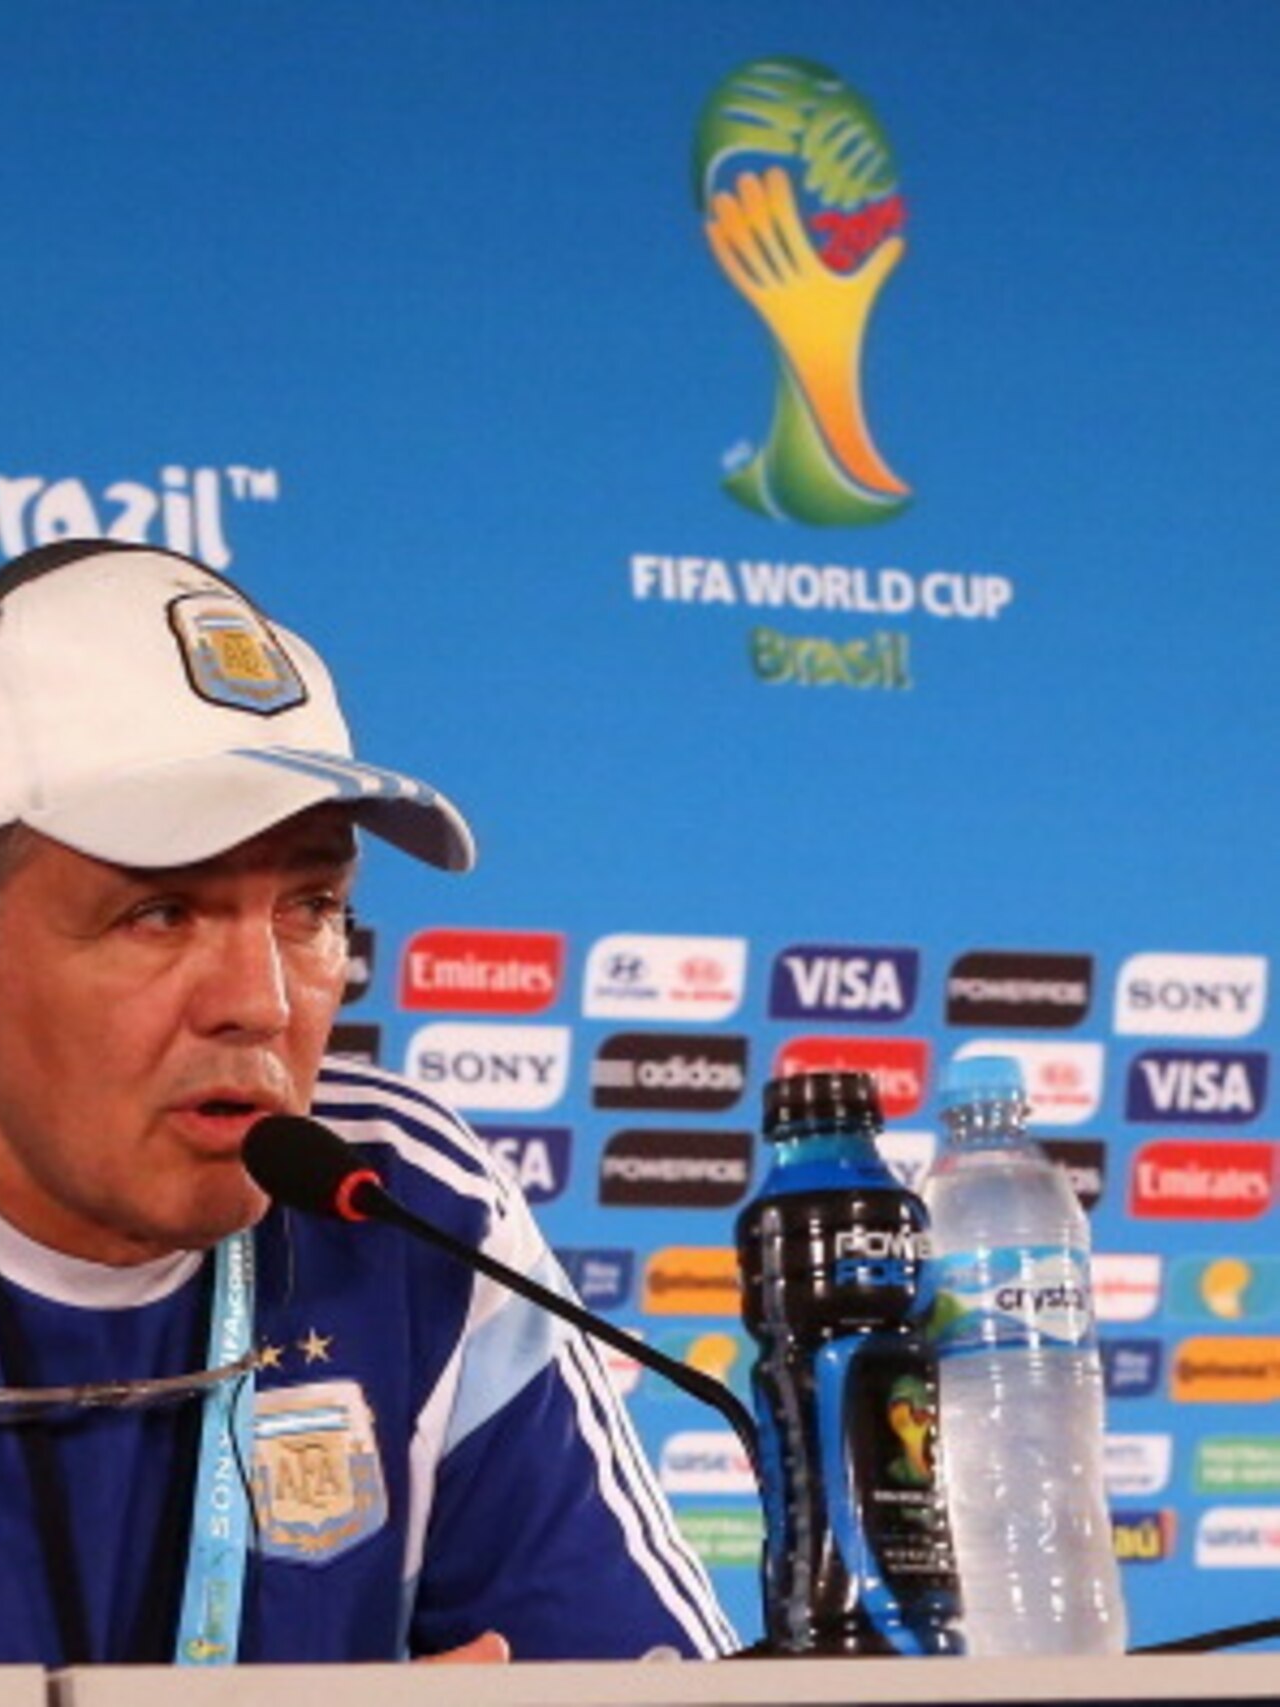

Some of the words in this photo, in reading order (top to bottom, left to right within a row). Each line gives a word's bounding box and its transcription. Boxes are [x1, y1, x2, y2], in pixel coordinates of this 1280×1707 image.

[631, 553, 734, 603] FIFA
[739, 560, 915, 614] WORLD
[920, 571, 1014, 619] CUP
[750, 625, 913, 691] Brasil
[408, 951, 553, 995] Emirates
[784, 957, 904, 1011] VISA
[1128, 980, 1255, 1013] SONY
[418, 1052, 556, 1085] SONY
[637, 1060, 743, 1091] adidas
[1140, 1060, 1255, 1113] VISA
[1136, 1161, 1271, 1200] Emirates
